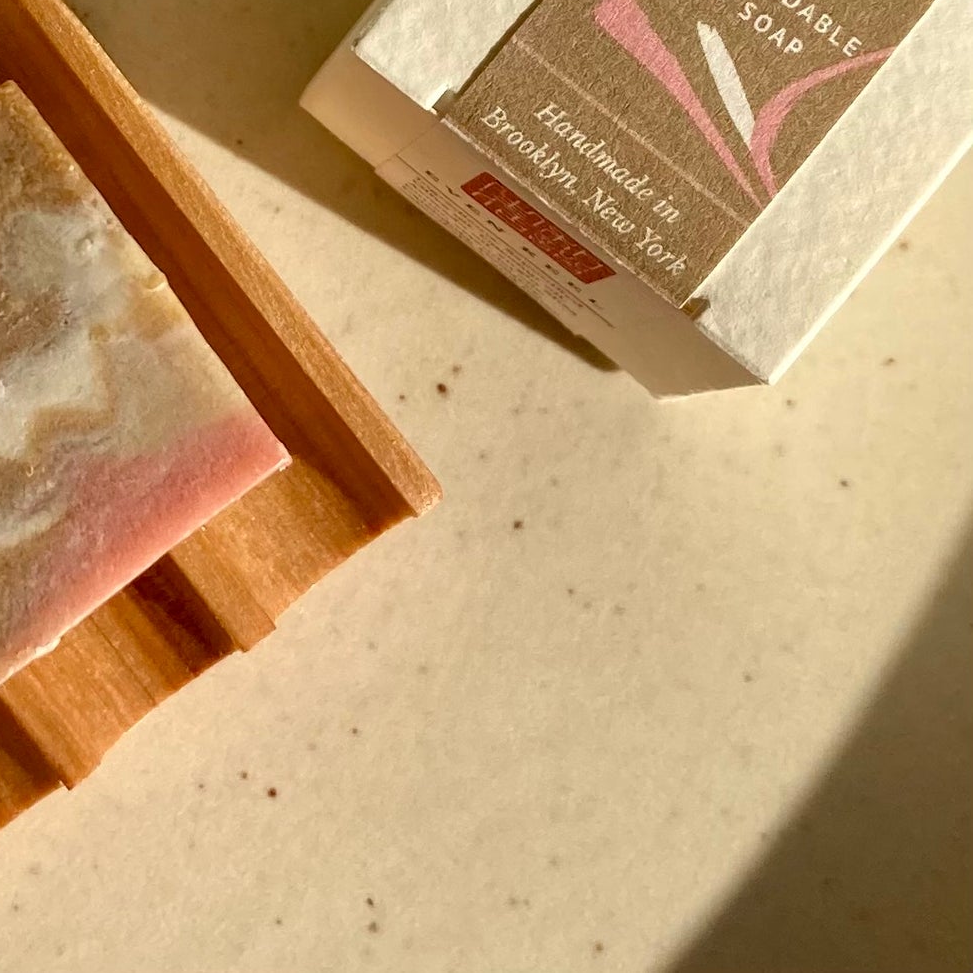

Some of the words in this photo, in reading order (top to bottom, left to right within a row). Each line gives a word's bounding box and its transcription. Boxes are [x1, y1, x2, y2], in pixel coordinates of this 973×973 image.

[738, 1, 805, 55] SOAP
[481, 105, 578, 196] Brooklyn,
[583, 186, 636, 234] New
[635, 226, 688, 277] York
[534, 102, 654, 202] Handmade
[652, 193, 682, 224] in
